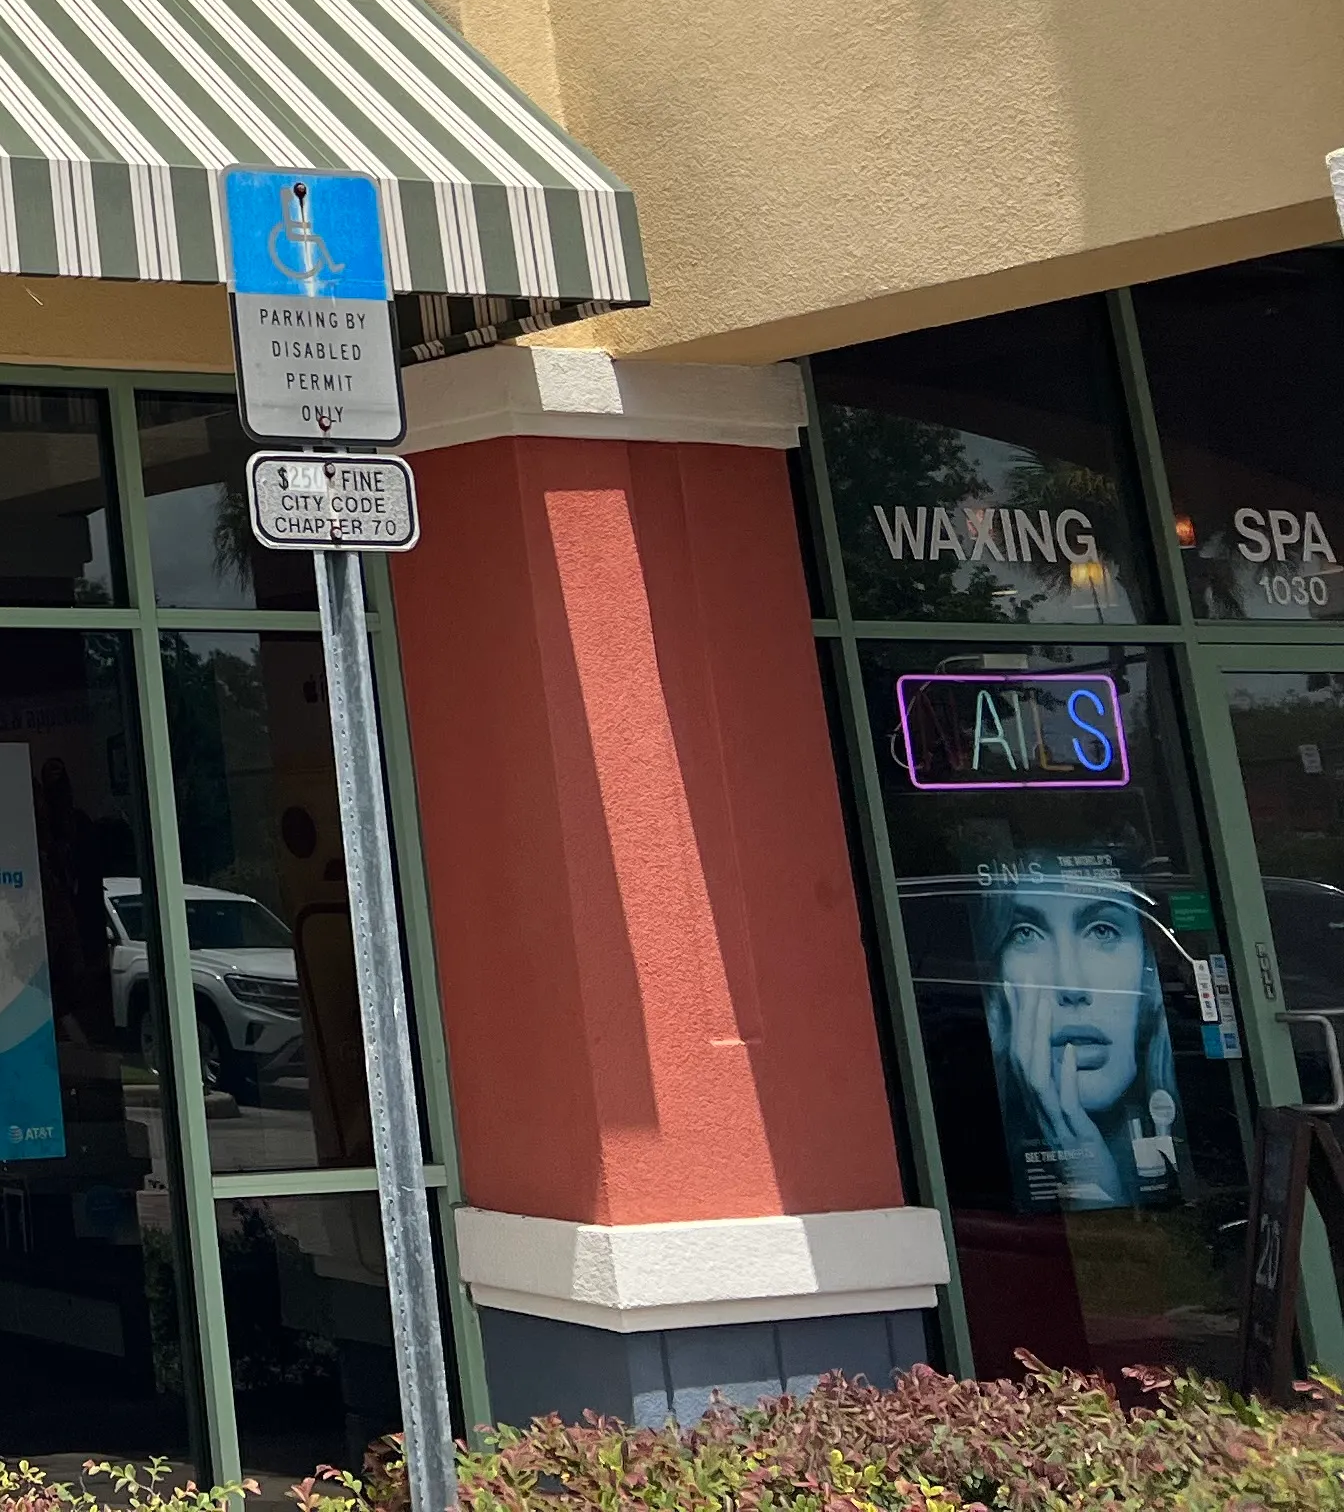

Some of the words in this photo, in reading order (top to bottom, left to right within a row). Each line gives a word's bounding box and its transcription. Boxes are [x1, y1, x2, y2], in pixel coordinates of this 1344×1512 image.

[259, 308, 338, 330] PARKING
[345, 311, 366, 331] BY
[272, 339, 362, 361] DISABLED
[286, 372, 353, 393] PERMIT
[301, 404, 345, 424] ONLY
[341, 470, 385, 493] FINE
[280, 495, 324, 513] CITY
[331, 496, 387, 514] CODE
[274, 516, 363, 536] CHAPTER
[372, 519, 397, 537] 70
[874, 506, 1100, 563] WAXING
[1233, 507, 1338, 565] SPA
[1259, 575, 1330, 607] 1030
[24, 1126, 55, 1141] AT&T
